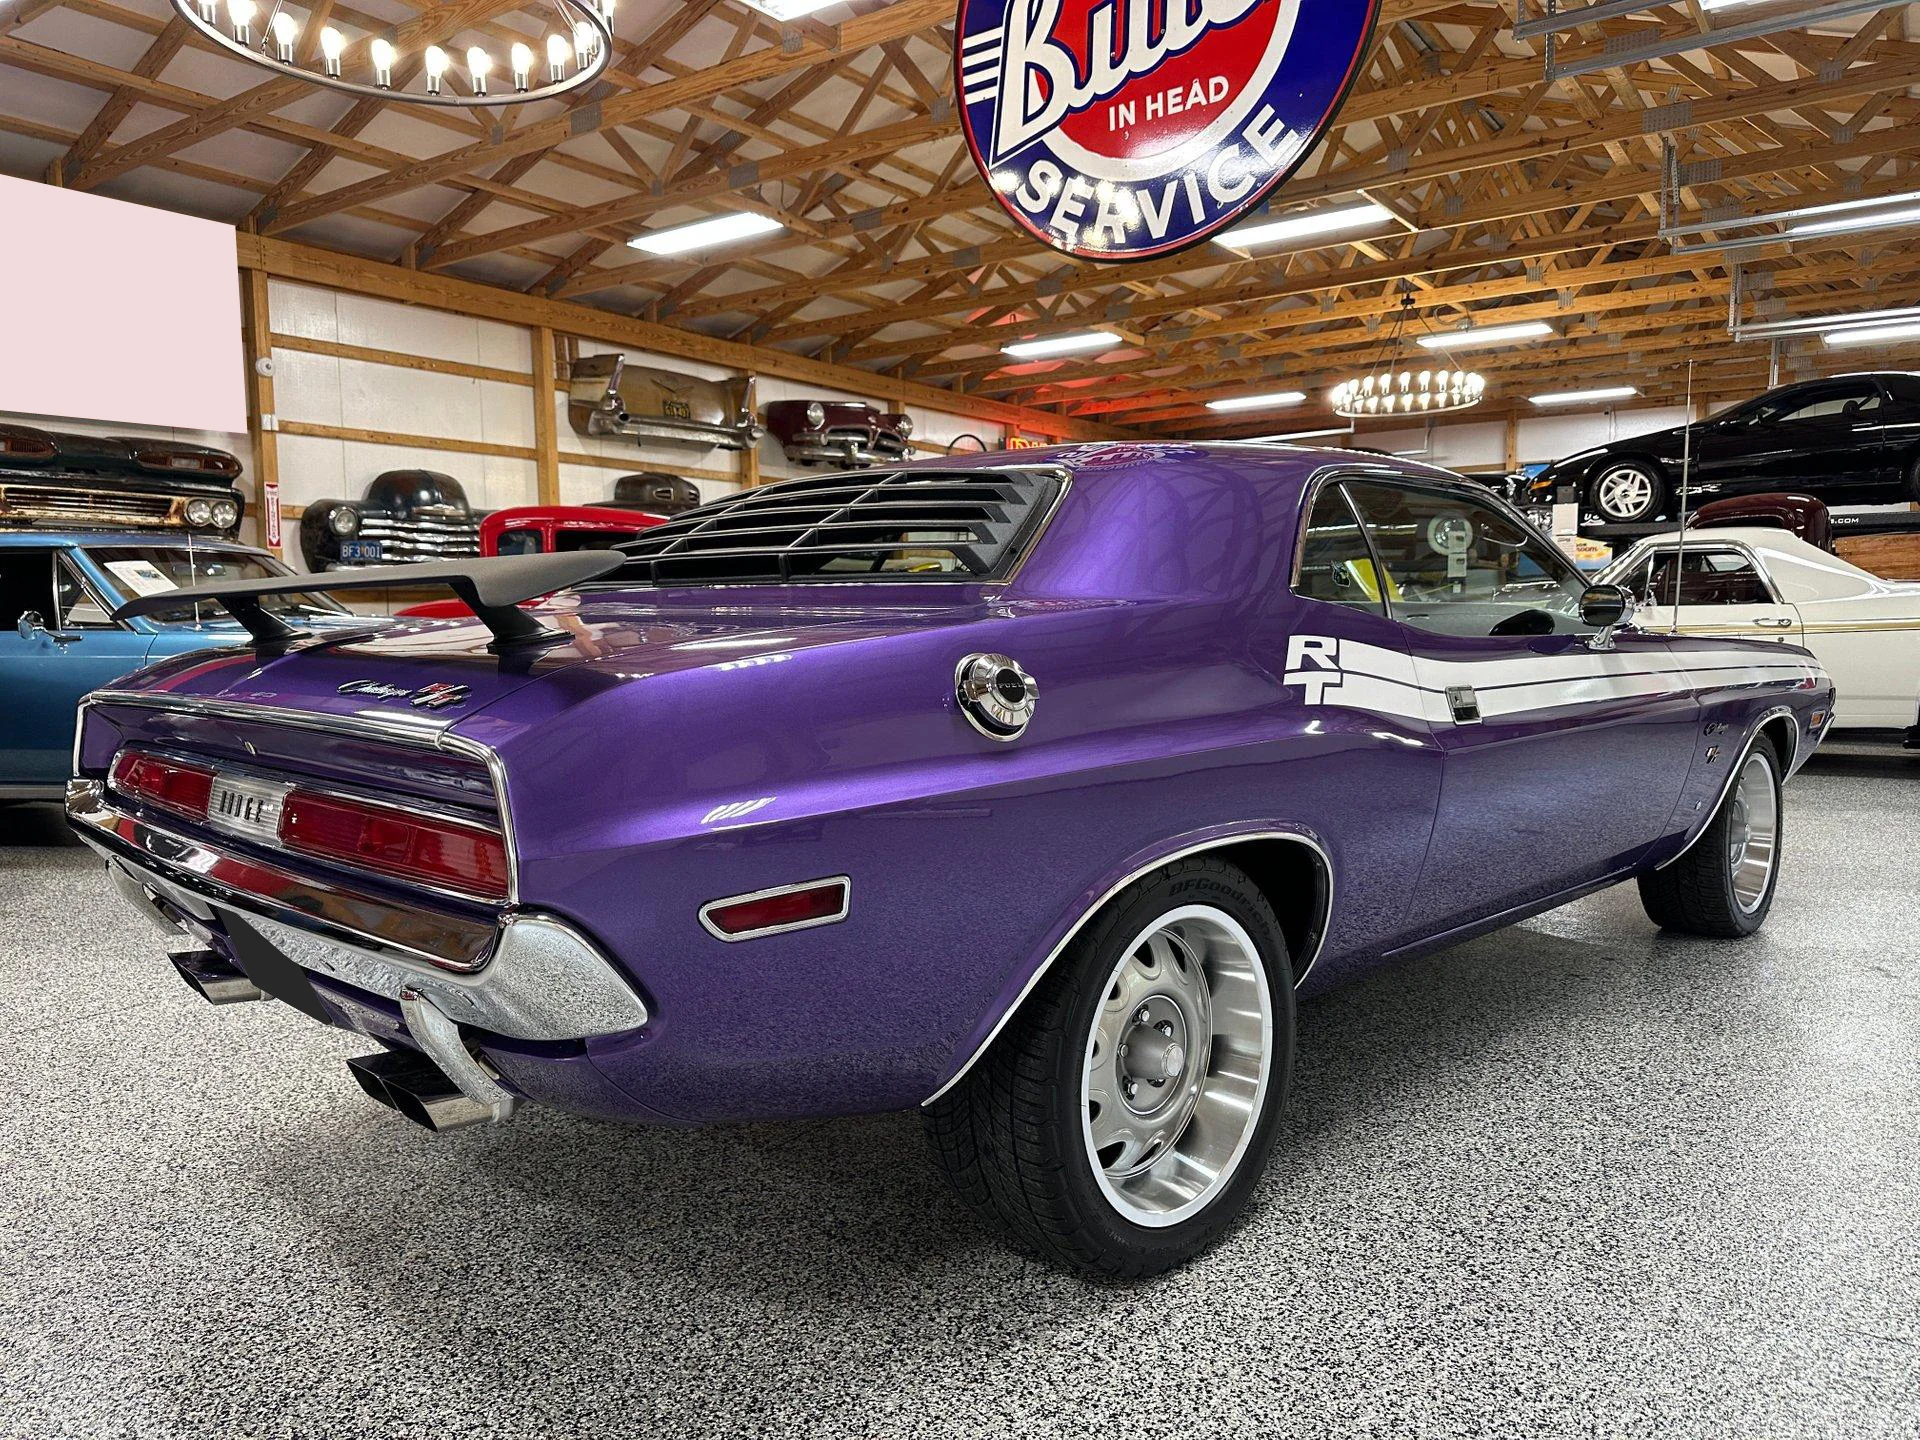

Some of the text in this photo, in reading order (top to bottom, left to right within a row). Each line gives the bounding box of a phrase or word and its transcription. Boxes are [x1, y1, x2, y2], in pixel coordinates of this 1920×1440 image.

[1108, 75, 1230, 132] IN HEAD
[1014, 103, 1300, 245] SERVICE
[342, 544, 361, 558] BF3
